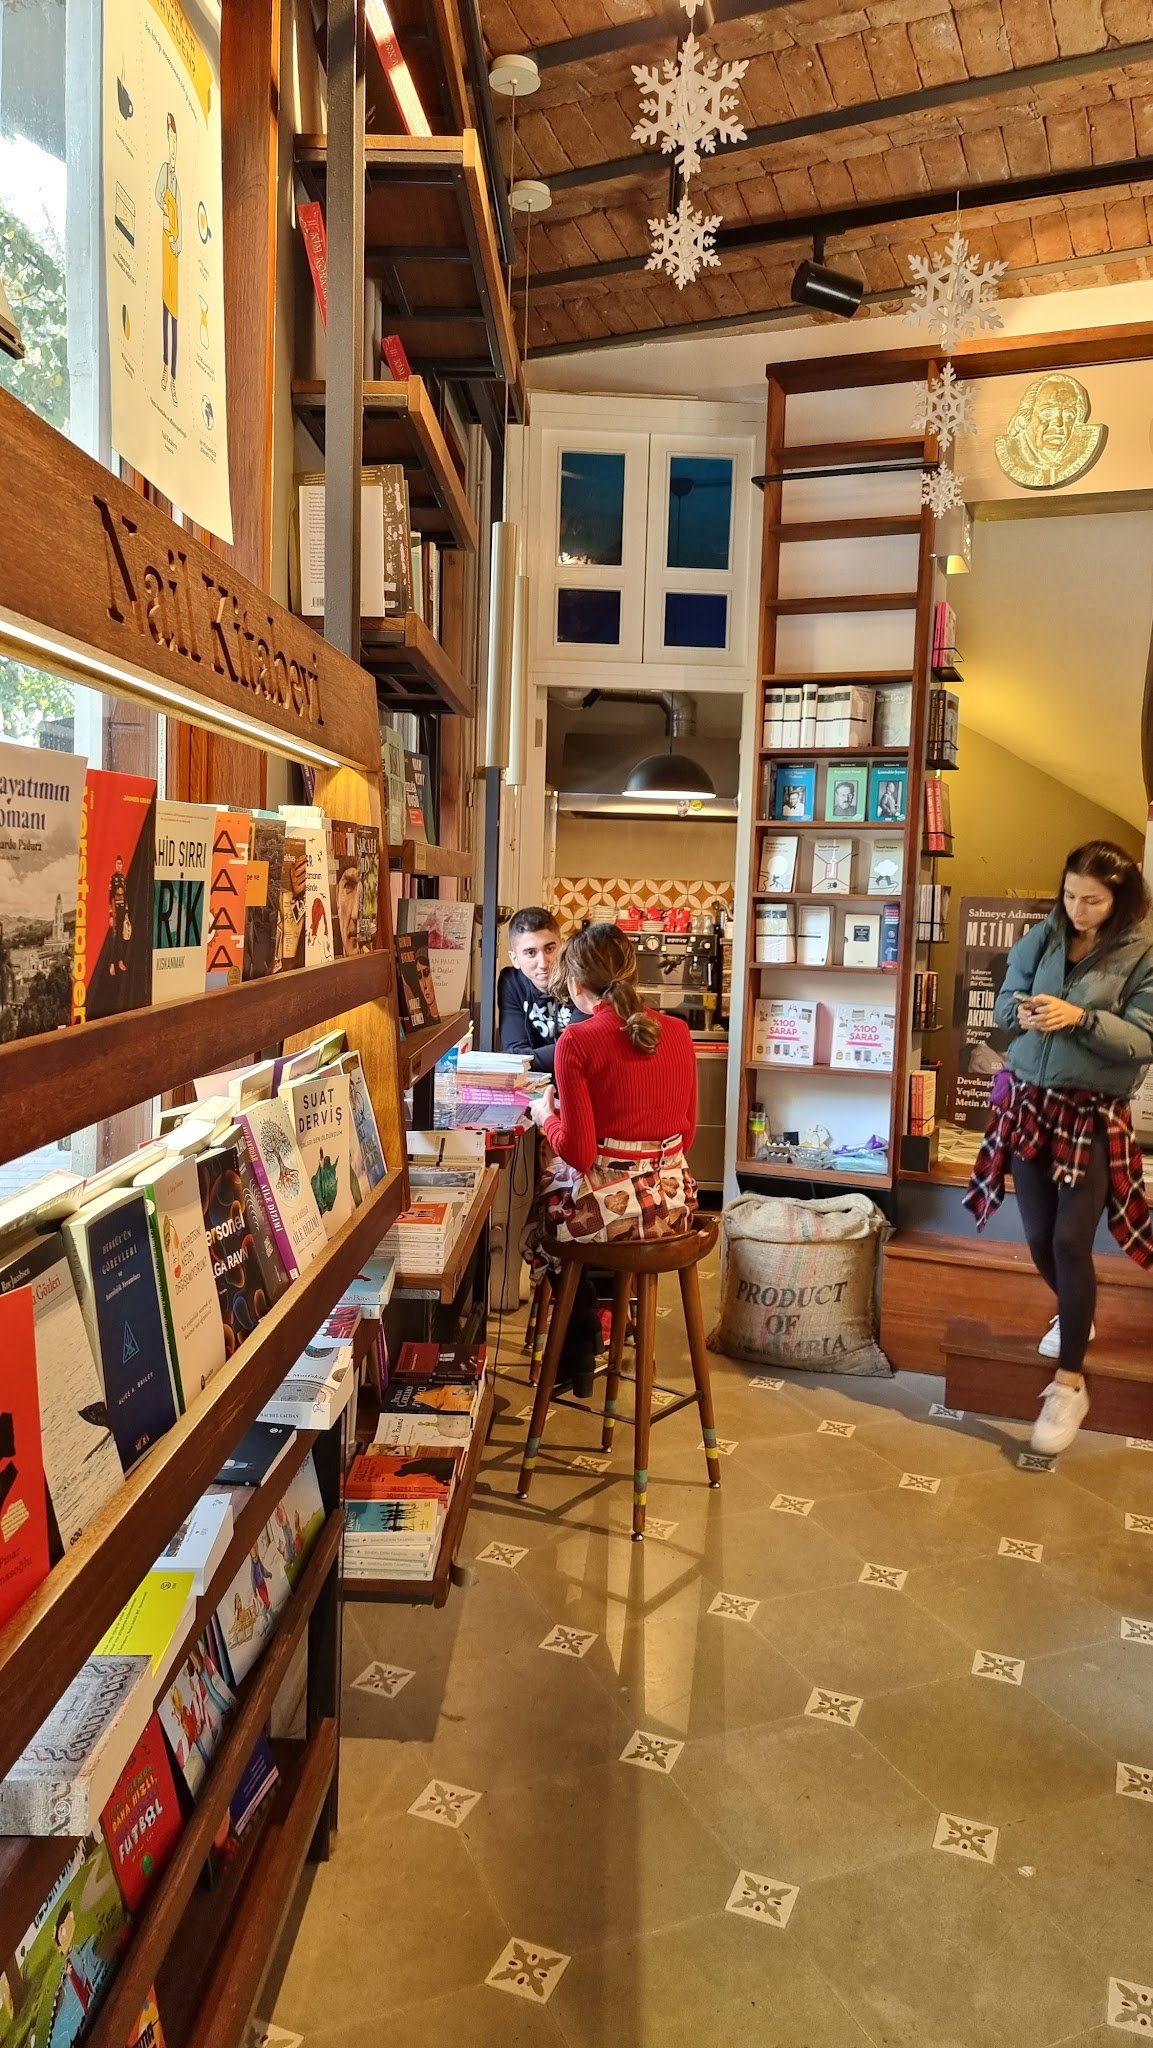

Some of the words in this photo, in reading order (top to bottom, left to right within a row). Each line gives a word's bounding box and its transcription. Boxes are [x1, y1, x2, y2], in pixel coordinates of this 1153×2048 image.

[92, 493, 203, 664] Nail
[19, 839, 42, 852] Padura
[178, 840, 207, 869] SIRRI
[968, 908, 1007, 920] Sahneye
[965, 920, 1015, 948] METİN
[968, 989, 996, 1009] METİN
[966, 1028, 992, 1039] Zeynep
[966, 1037, 987, 1047] Miraç
[303, 1088, 335, 1110] SUAT
[955, 1098, 980, 1108] Metin
[298, 1104, 343, 1135] DERVİŞ
[205, 1213, 246, 1247] ersonel
[226, 1246, 249, 1270] RAVN
[736, 1279, 848, 1309] PRODUCT
[765, 1314, 801, 1336] OF
[118, 1797, 164, 1865] FUTBOL
